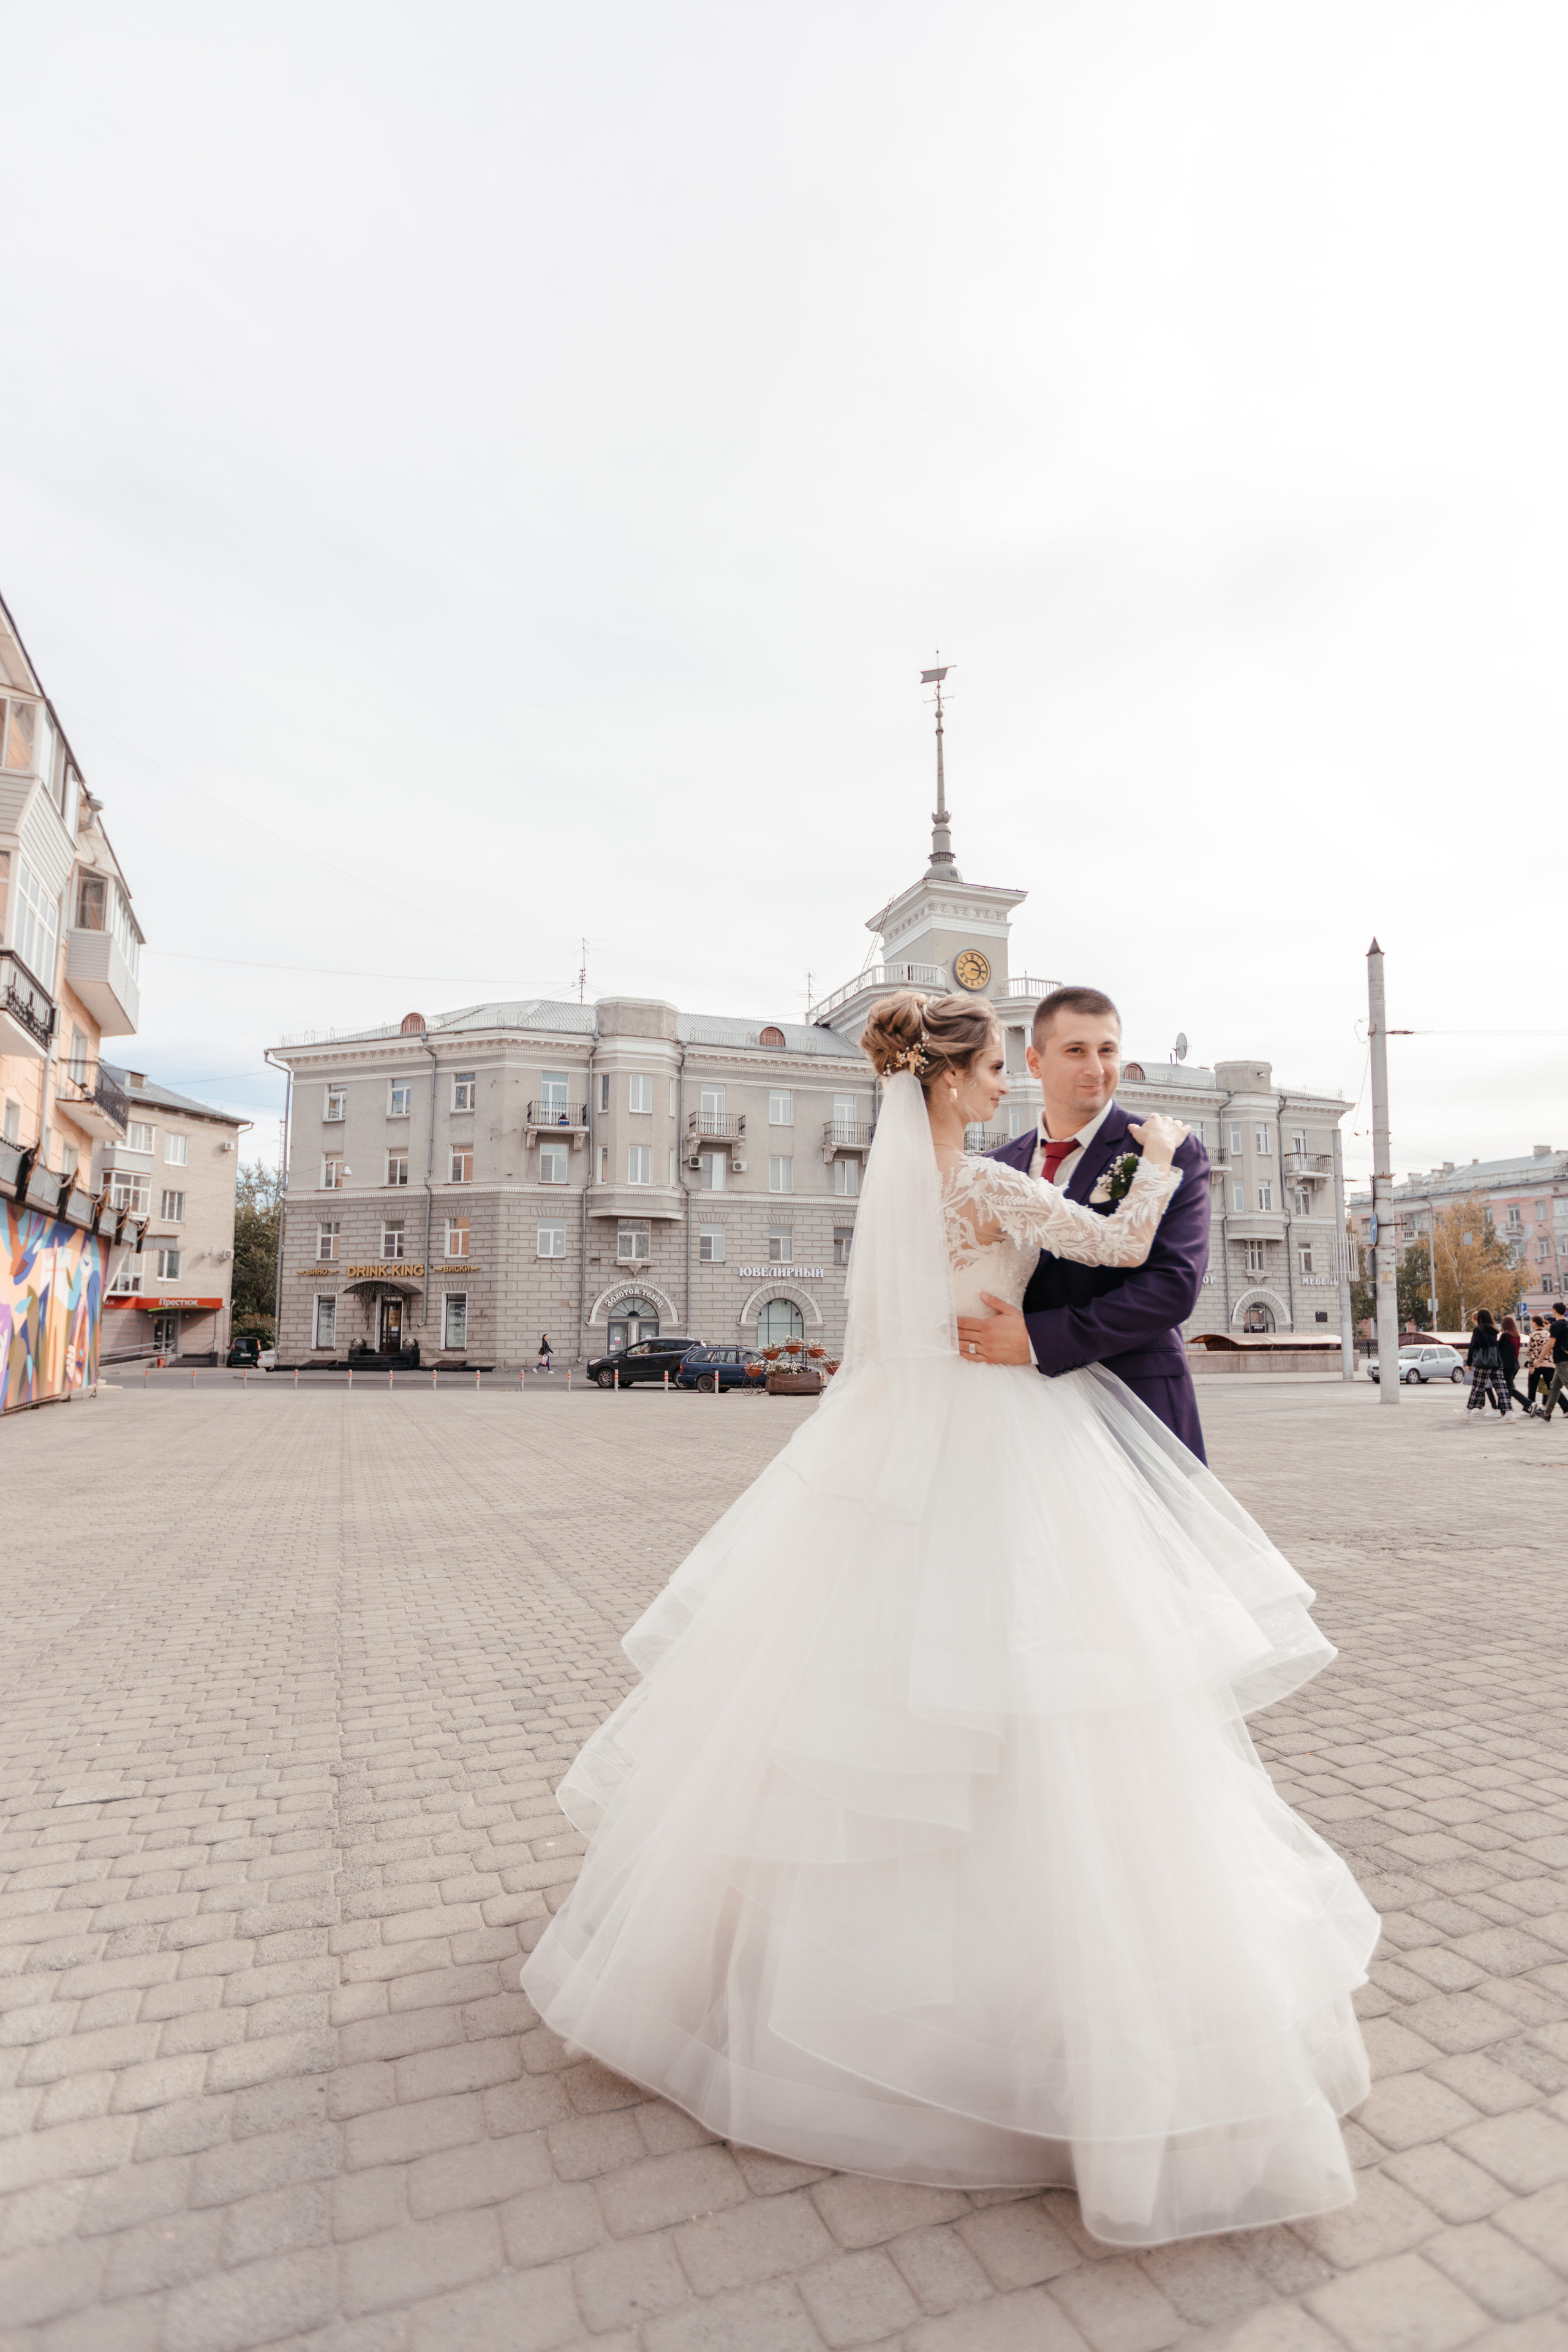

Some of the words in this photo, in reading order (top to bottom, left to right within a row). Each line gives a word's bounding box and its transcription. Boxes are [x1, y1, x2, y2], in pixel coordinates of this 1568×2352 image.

[347, 1265, 388, 1277] DRINK
[391, 1264, 424, 1276] KING
[739, 1266, 824, 1278] ЮВЕЛИРНЫЙ
[159, 1298, 198, 1307] Престиж
[604, 1287, 639, 1307] Золотой
[642, 1289, 664, 1308] телец
